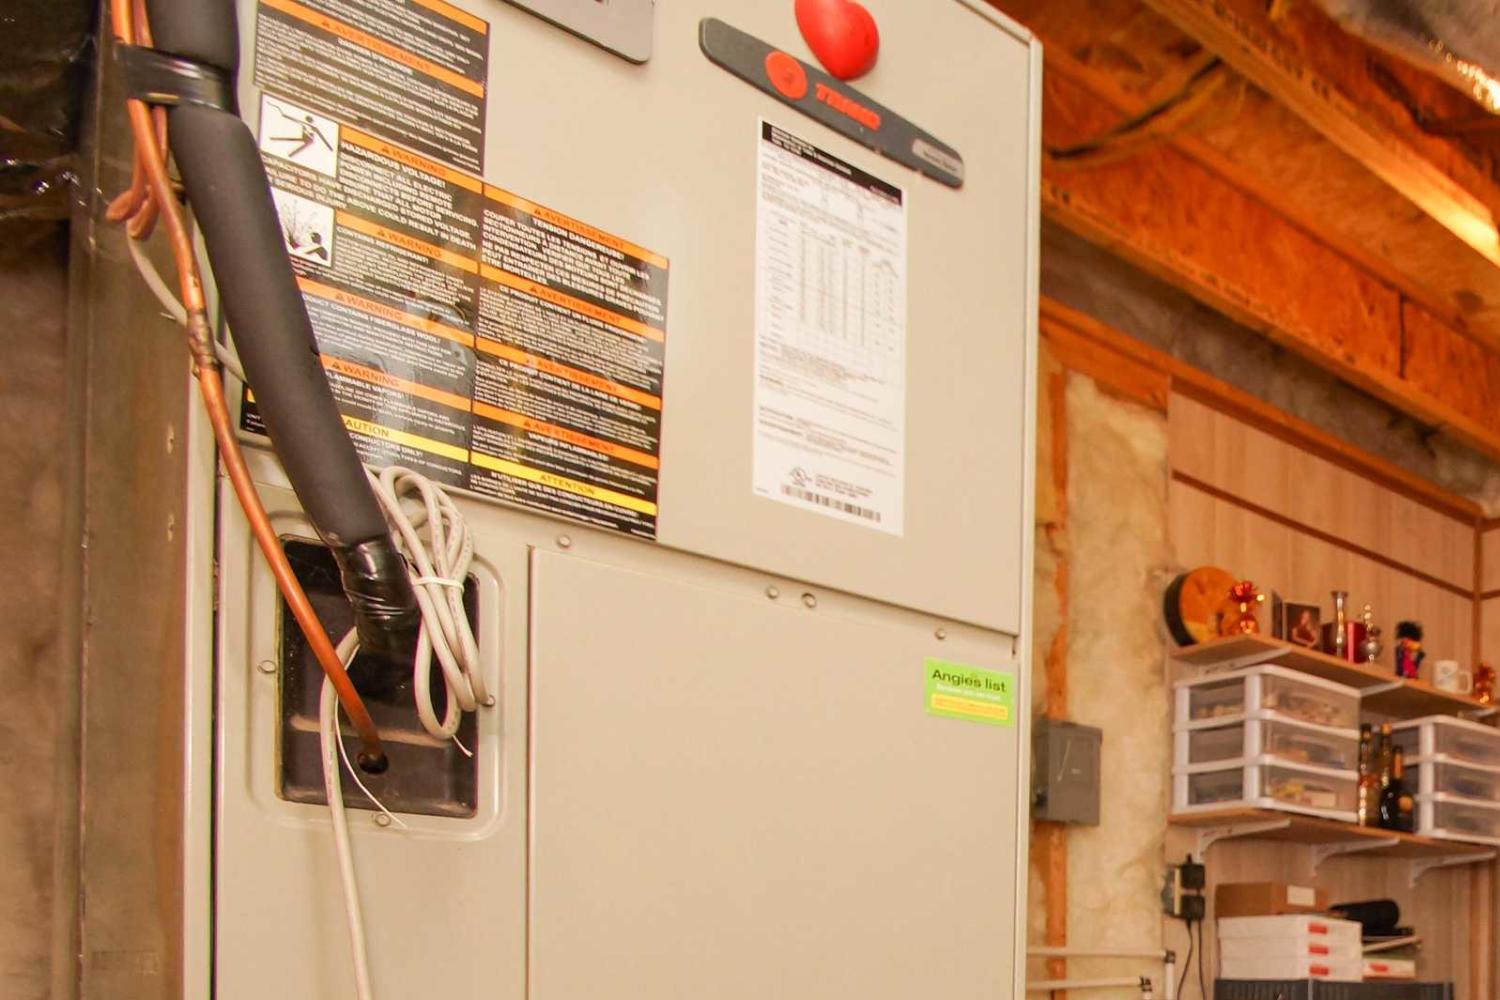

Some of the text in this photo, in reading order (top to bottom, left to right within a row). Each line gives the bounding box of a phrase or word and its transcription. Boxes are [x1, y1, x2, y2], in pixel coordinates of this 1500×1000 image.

[340, 139, 445, 188] HAZARDOUS VOLTAGE!
[393, 148, 445, 177] WARNING
[532, 217, 567, 238] TENSION
[545, 210, 624, 249] AVERTISSEMENT
[388, 232, 441, 258] WARNING
[347, 295, 402, 321] WARNING
[343, 363, 399, 388] WARNING
[345, 418, 389, 438] AUTION
[540, 473, 594, 495] ATTENTION
